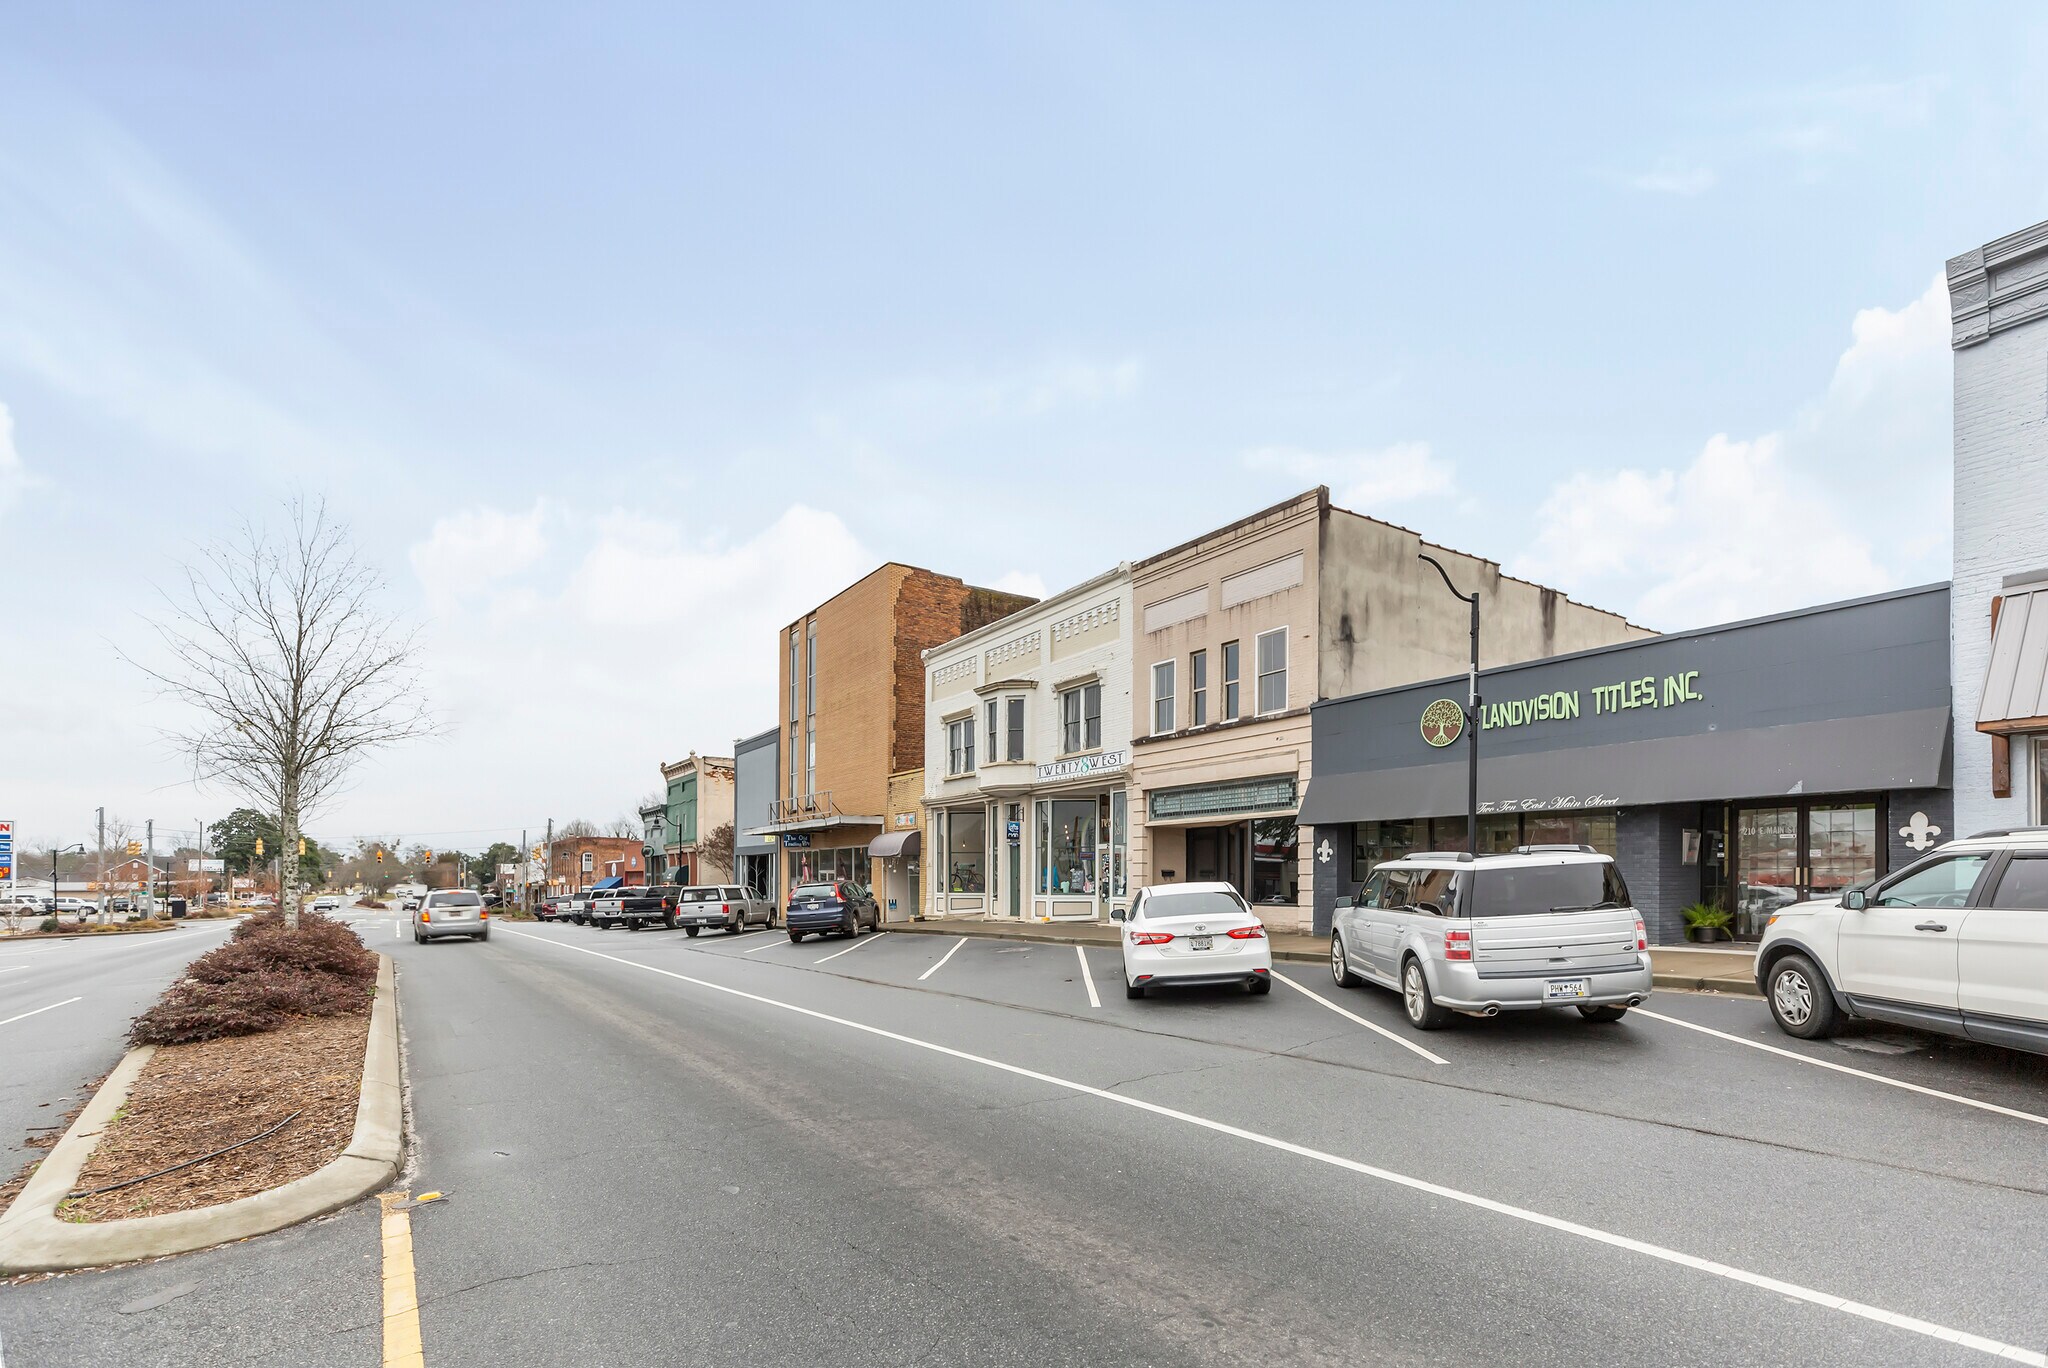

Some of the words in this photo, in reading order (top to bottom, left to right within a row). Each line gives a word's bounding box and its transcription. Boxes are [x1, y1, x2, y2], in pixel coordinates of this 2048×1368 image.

[1480, 690, 1579, 730] LANDVISION
[1591, 676, 1658, 715] TITLES,
[1663, 671, 1703, 707] INC.
[1037, 760, 1080, 777] TWENTY
[1089, 753, 1123, 768] WEST
[1477, 801, 1495, 813] Two
[1496, 799, 1518, 812] Ten
[1520, 798, 1547, 811] East
[1548, 795, 1581, 809] Main
[1584, 793, 1620, 807] Street
[0, 823, 10, 831] N
[1743, 827, 1756, 836] 210
[1766, 825, 1785, 834] MAIN
[1569, 983, 1583, 991] 564
